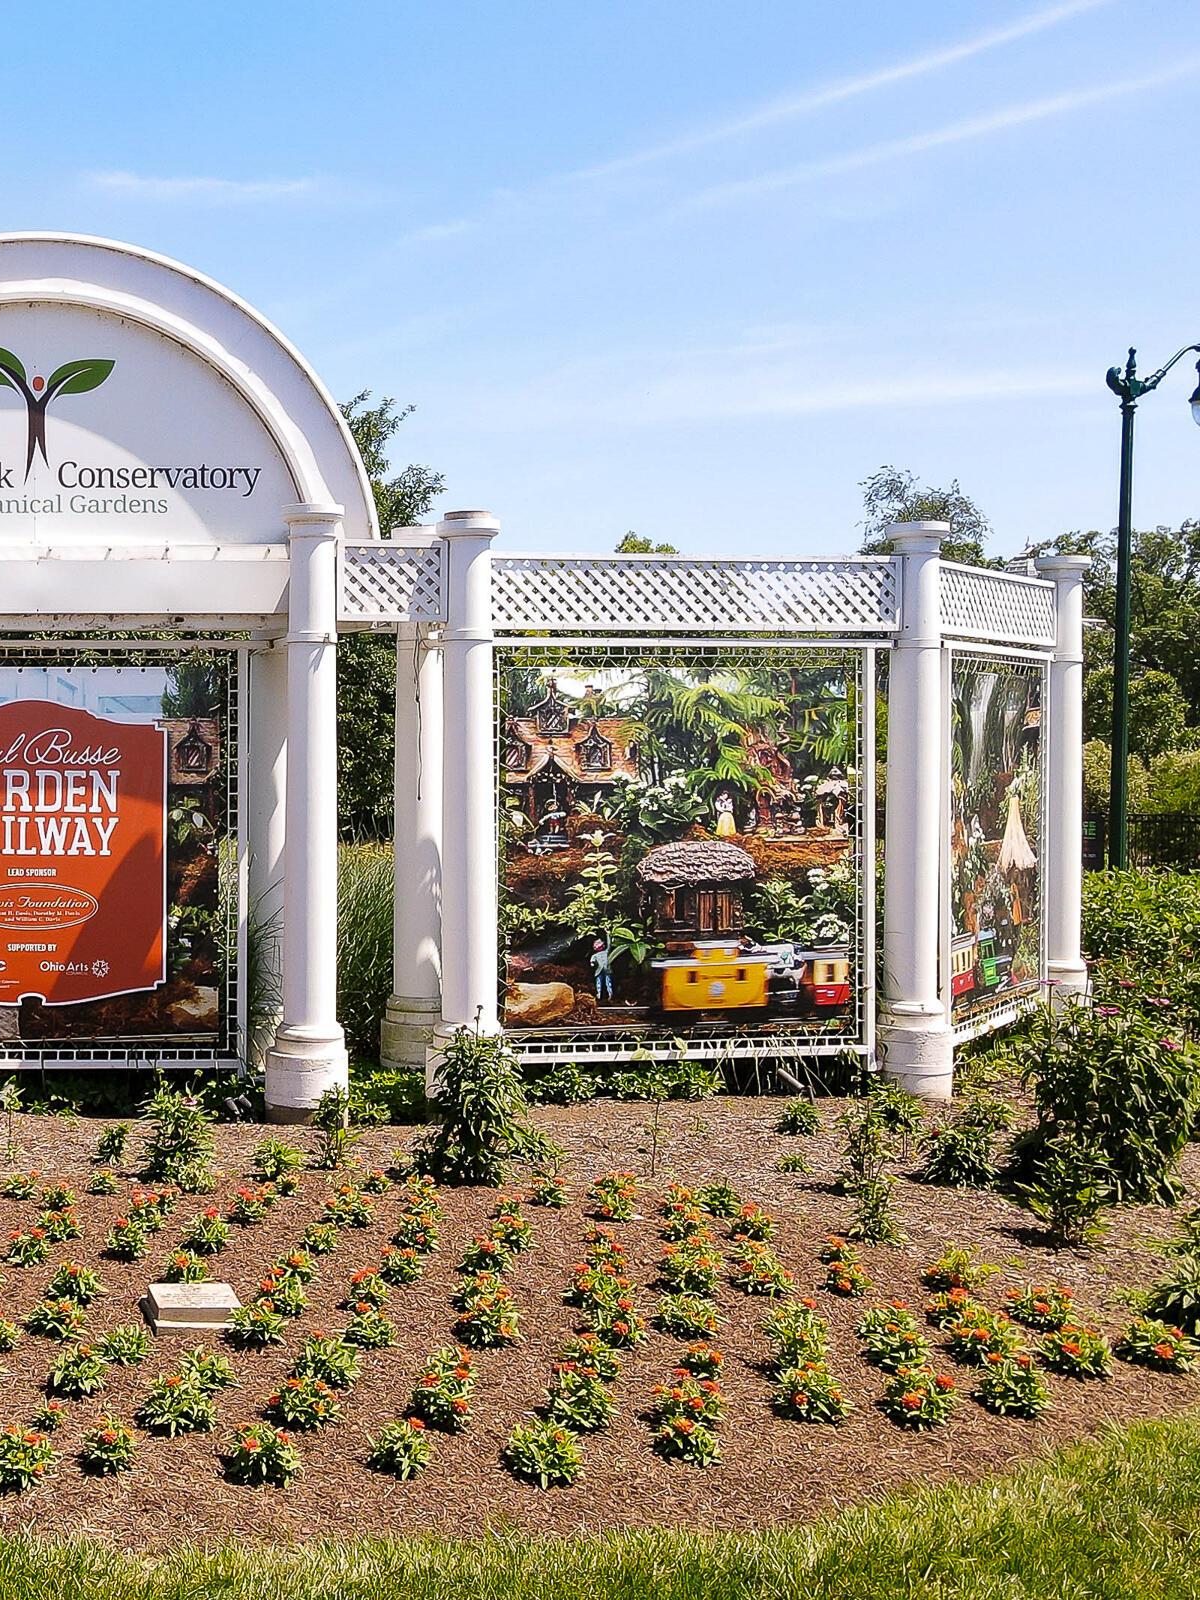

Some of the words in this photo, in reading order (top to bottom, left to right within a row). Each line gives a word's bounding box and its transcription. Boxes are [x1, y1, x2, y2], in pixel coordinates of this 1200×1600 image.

[58, 461, 262, 497] Conservatory
[69, 494, 168, 514] Gardens
[23, 727, 122, 765] Busse
[7, 868, 25, 877] LEAD
[25, 868, 57, 877] SPONSOR
[17, 896, 90, 908] Foundation
[7, 943, 47, 952] SUPPORTED
[47, 943, 57, 952] BY
[40, 961, 66, 972] Ohio
[66, 961, 89, 972] Arts
